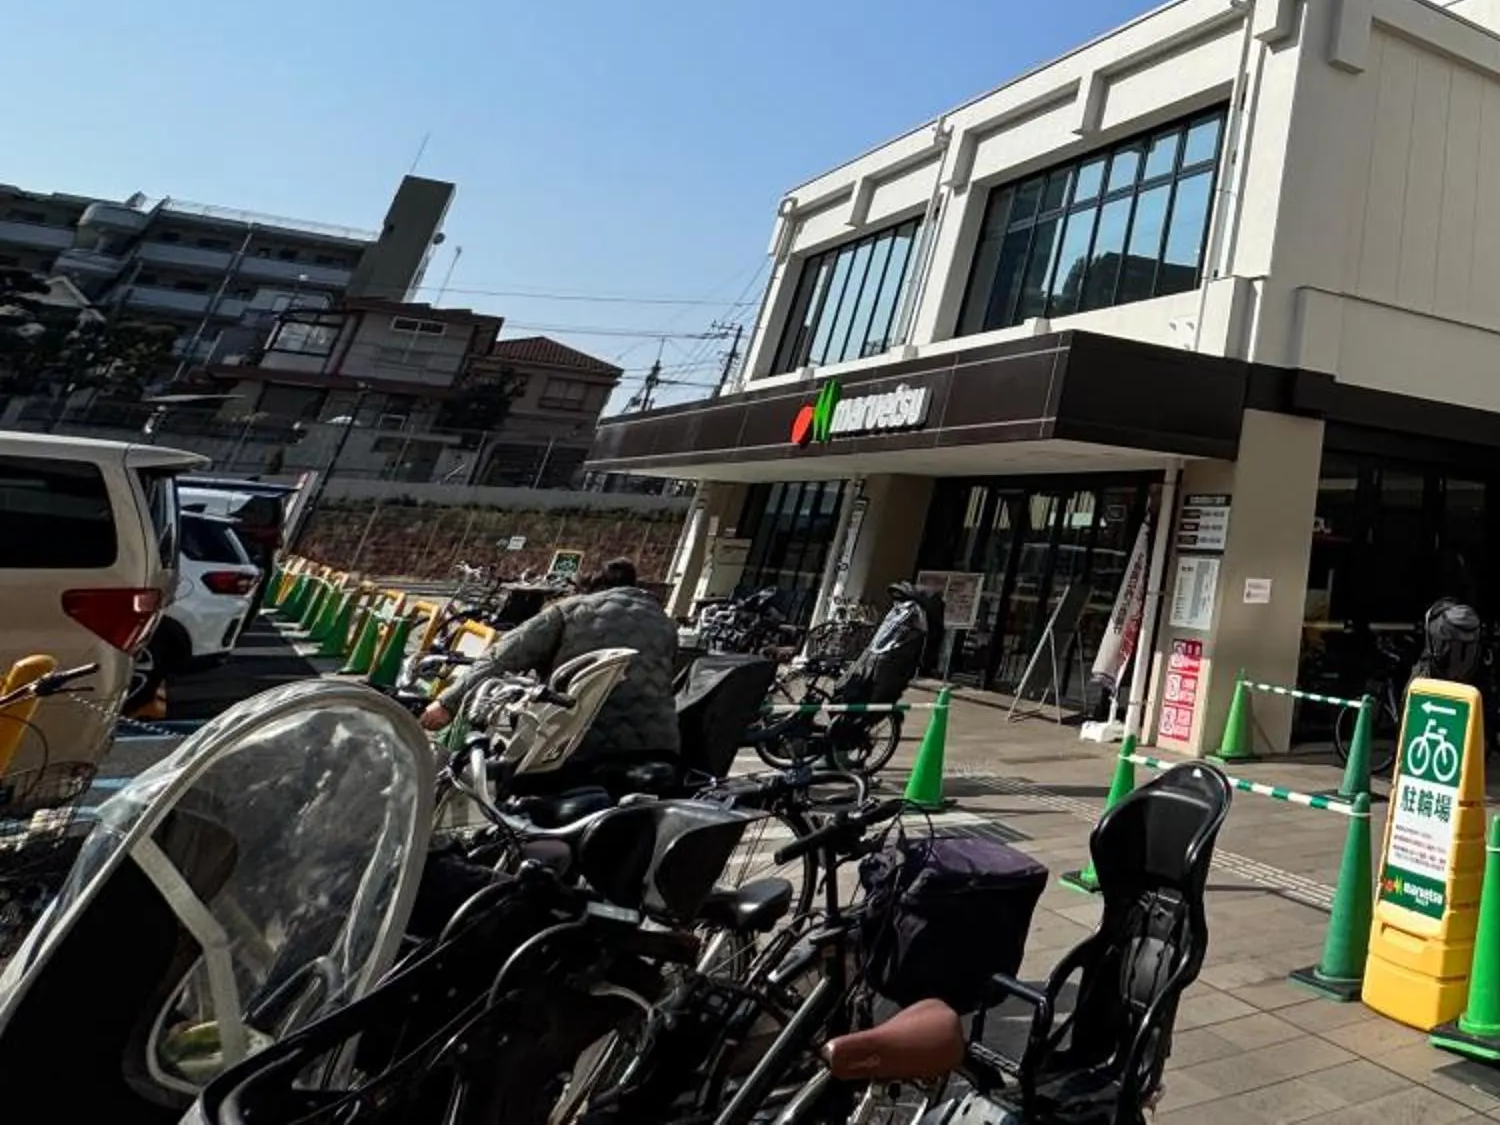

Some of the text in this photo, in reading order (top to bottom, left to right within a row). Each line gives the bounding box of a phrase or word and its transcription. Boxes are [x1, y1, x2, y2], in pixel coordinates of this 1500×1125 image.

[829, 383, 927, 433] maruetsu
[1401, 783, 1453, 824] 駐輪場
[1403, 881, 1444, 905] maruetsu
